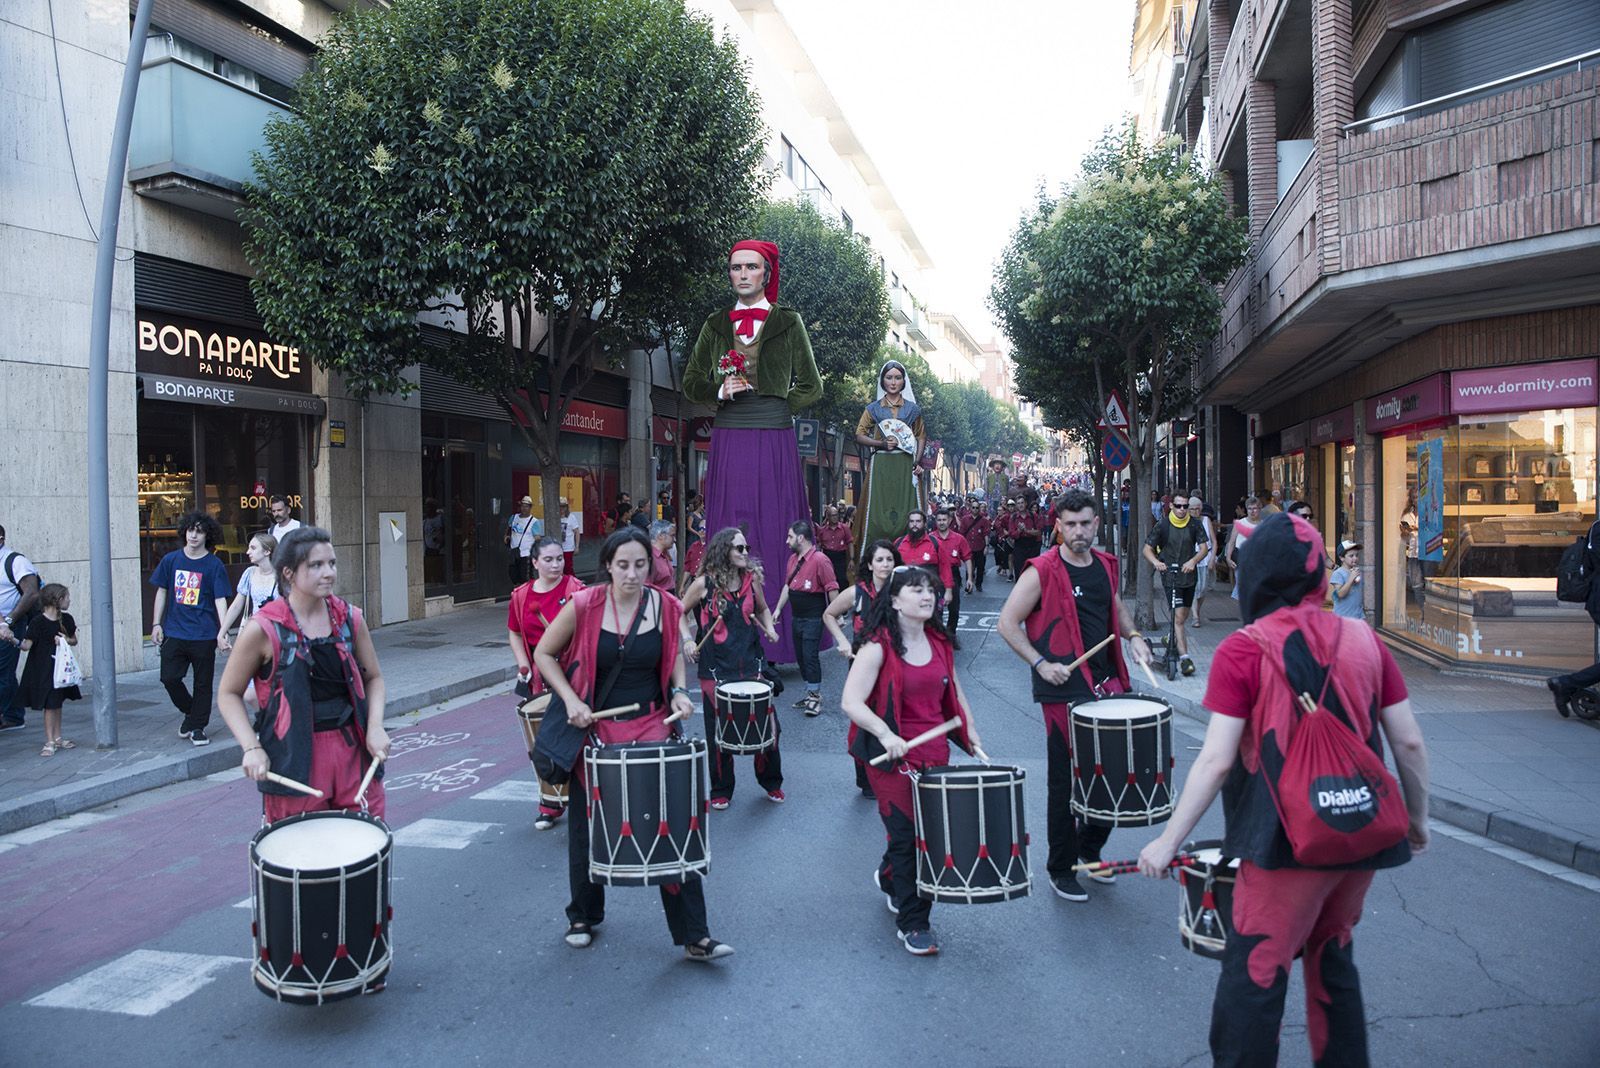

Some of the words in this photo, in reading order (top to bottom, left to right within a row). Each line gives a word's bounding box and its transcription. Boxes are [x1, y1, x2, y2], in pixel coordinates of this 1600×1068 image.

[139, 321, 300, 378] BONAPARTE
[199, 362, 213, 374] PA
[218, 363, 222, 375] I
[226, 366, 253, 382] DOLÇ
[156, 382, 235, 403] BONAPARTE
[1458, 376, 1593, 396] www.dormity.com
[278, 397, 289, 406] PA
[297, 399, 318, 411] DOLÇ
[799, 423, 813, 441] P
